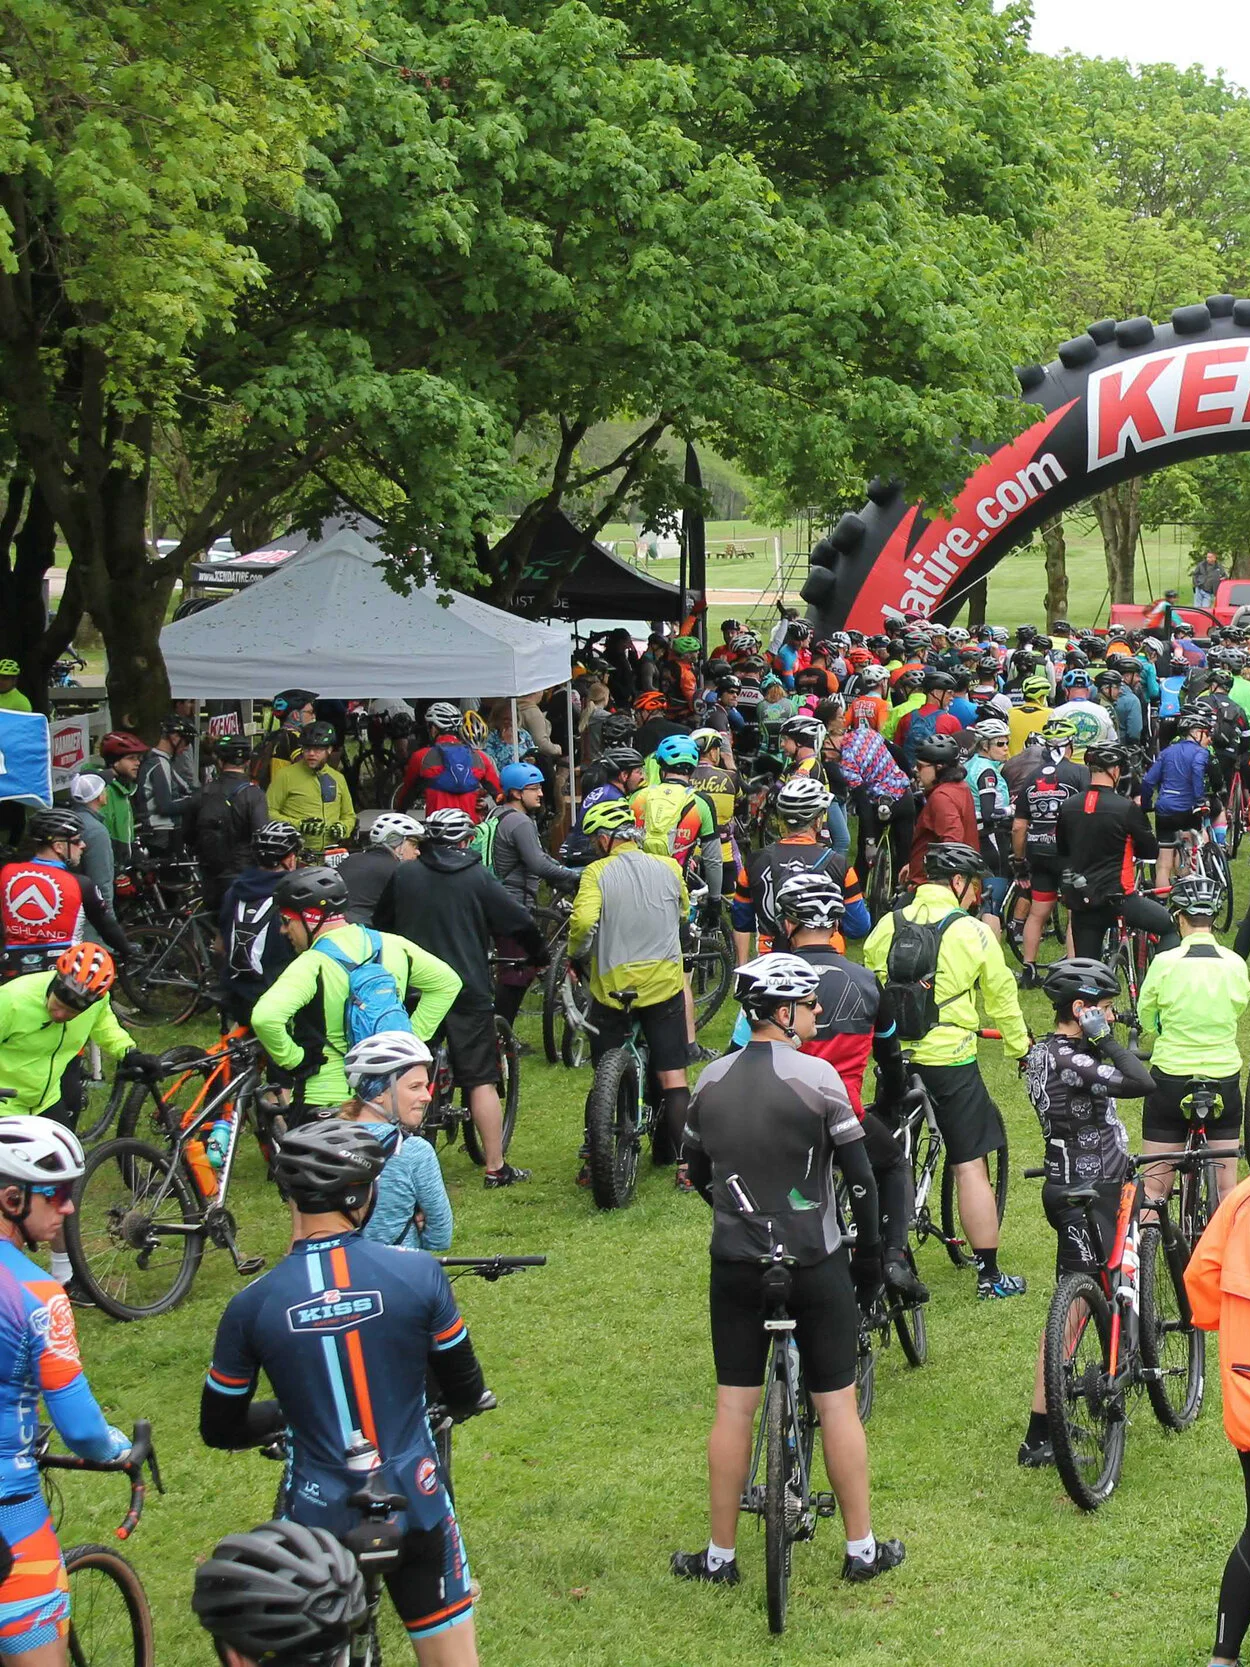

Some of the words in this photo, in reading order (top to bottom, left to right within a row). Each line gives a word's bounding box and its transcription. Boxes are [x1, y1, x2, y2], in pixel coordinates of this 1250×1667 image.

[880, 453, 1068, 618] atire.com
[6, 925, 68, 939] ASHLAND
[765, 977, 792, 986] KASK
[351, 1152, 372, 1171] GIRO
[306, 1238, 342, 1252] KRT
[298, 1297, 373, 1324] KISS
